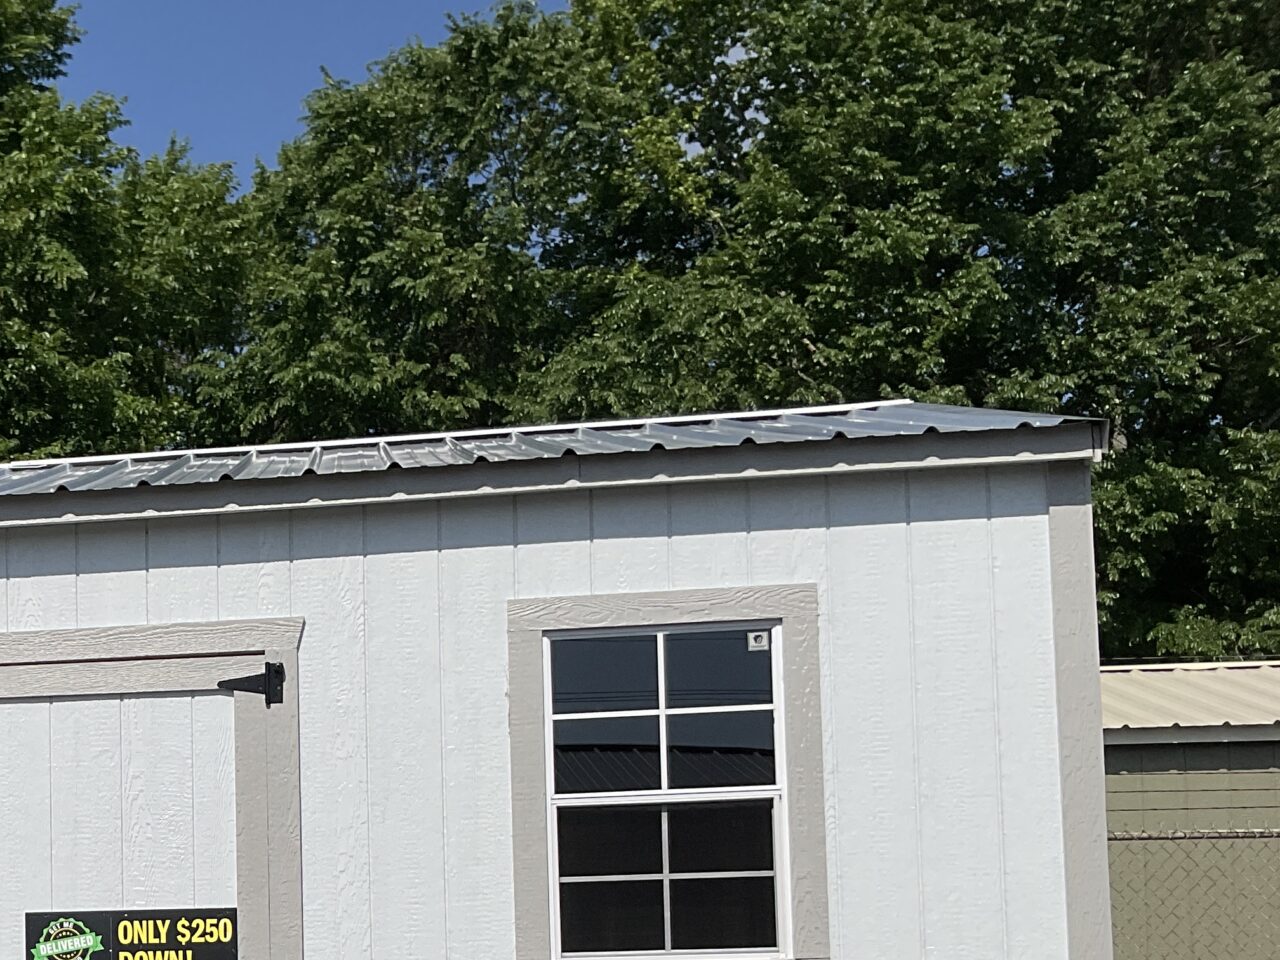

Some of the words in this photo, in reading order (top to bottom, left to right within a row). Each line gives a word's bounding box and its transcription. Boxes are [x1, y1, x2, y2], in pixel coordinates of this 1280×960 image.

[48, 923, 61, 935] GET
[63, 921, 74, 929] ME
[118, 919, 171, 944] ONLY
[176, 917, 233, 945] $250
[39, 935, 94, 956] DELIVERED
